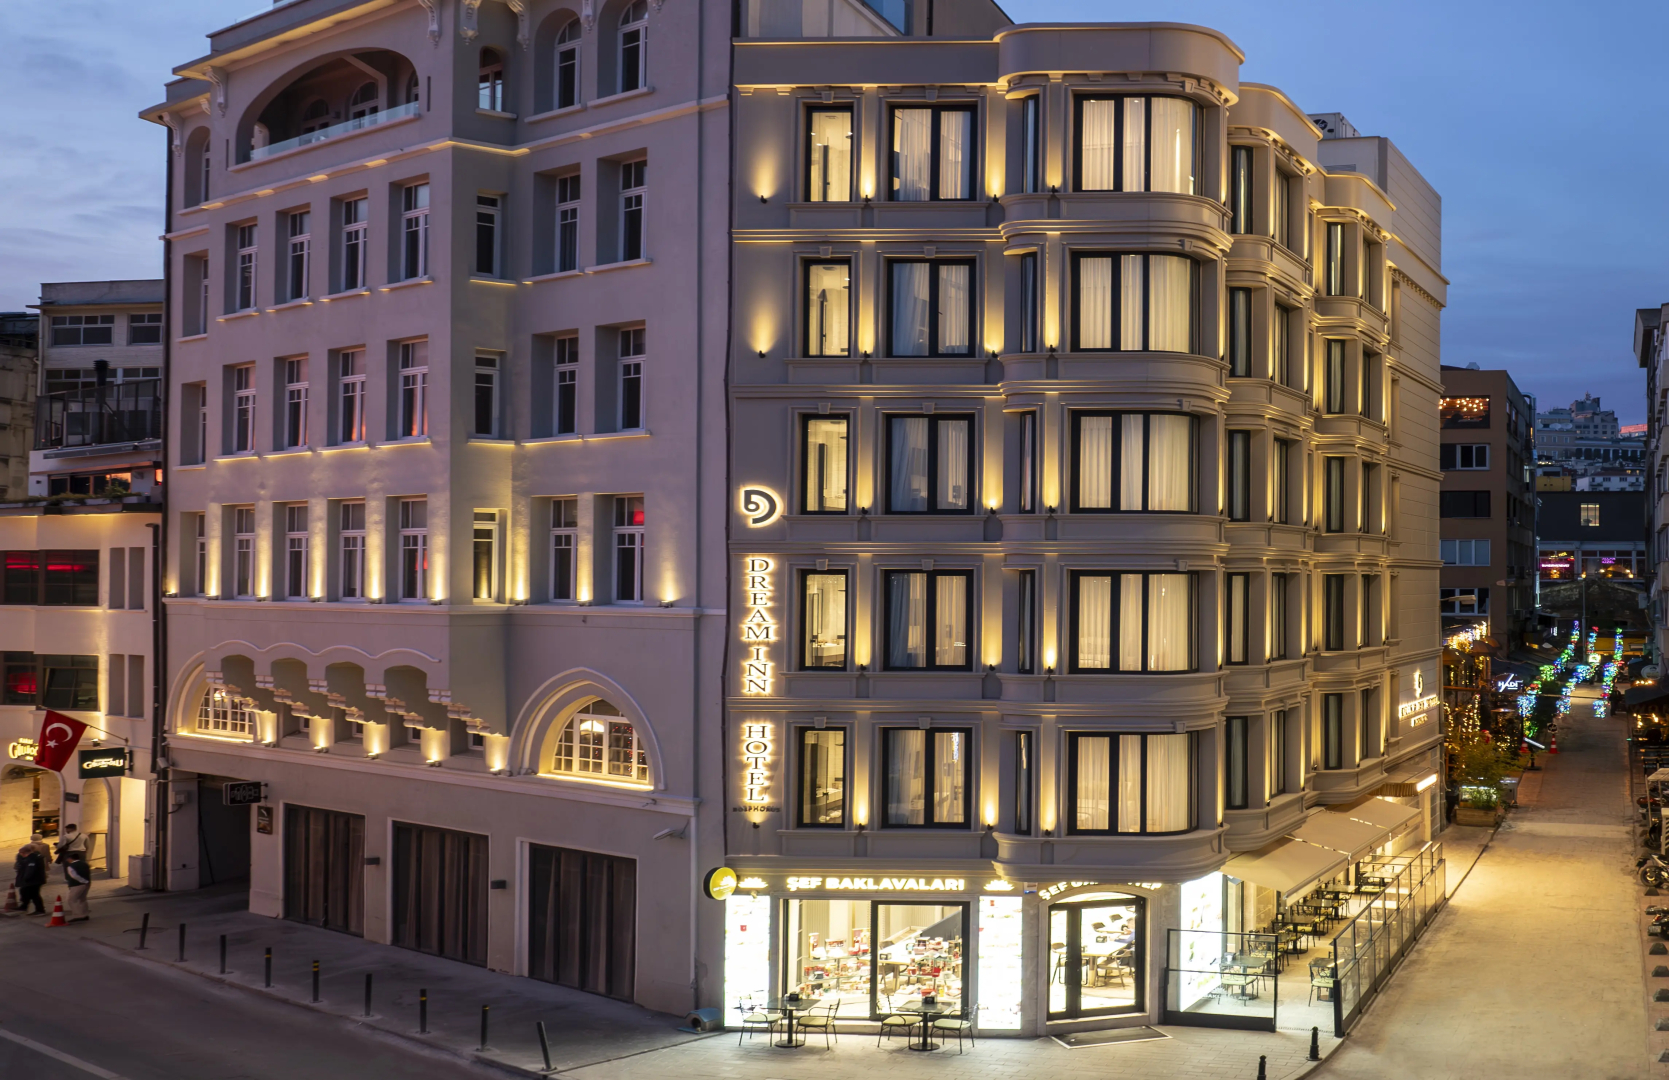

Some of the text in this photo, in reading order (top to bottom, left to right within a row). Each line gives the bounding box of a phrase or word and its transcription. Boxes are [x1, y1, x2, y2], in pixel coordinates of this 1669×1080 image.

[745, 558, 773, 693] DREAM INN
[745, 725, 769, 802] HOTEL
[787, 877, 965, 891] ŞEF BAKLAVALARI
[1038, 881, 1068, 900] ŞEF
